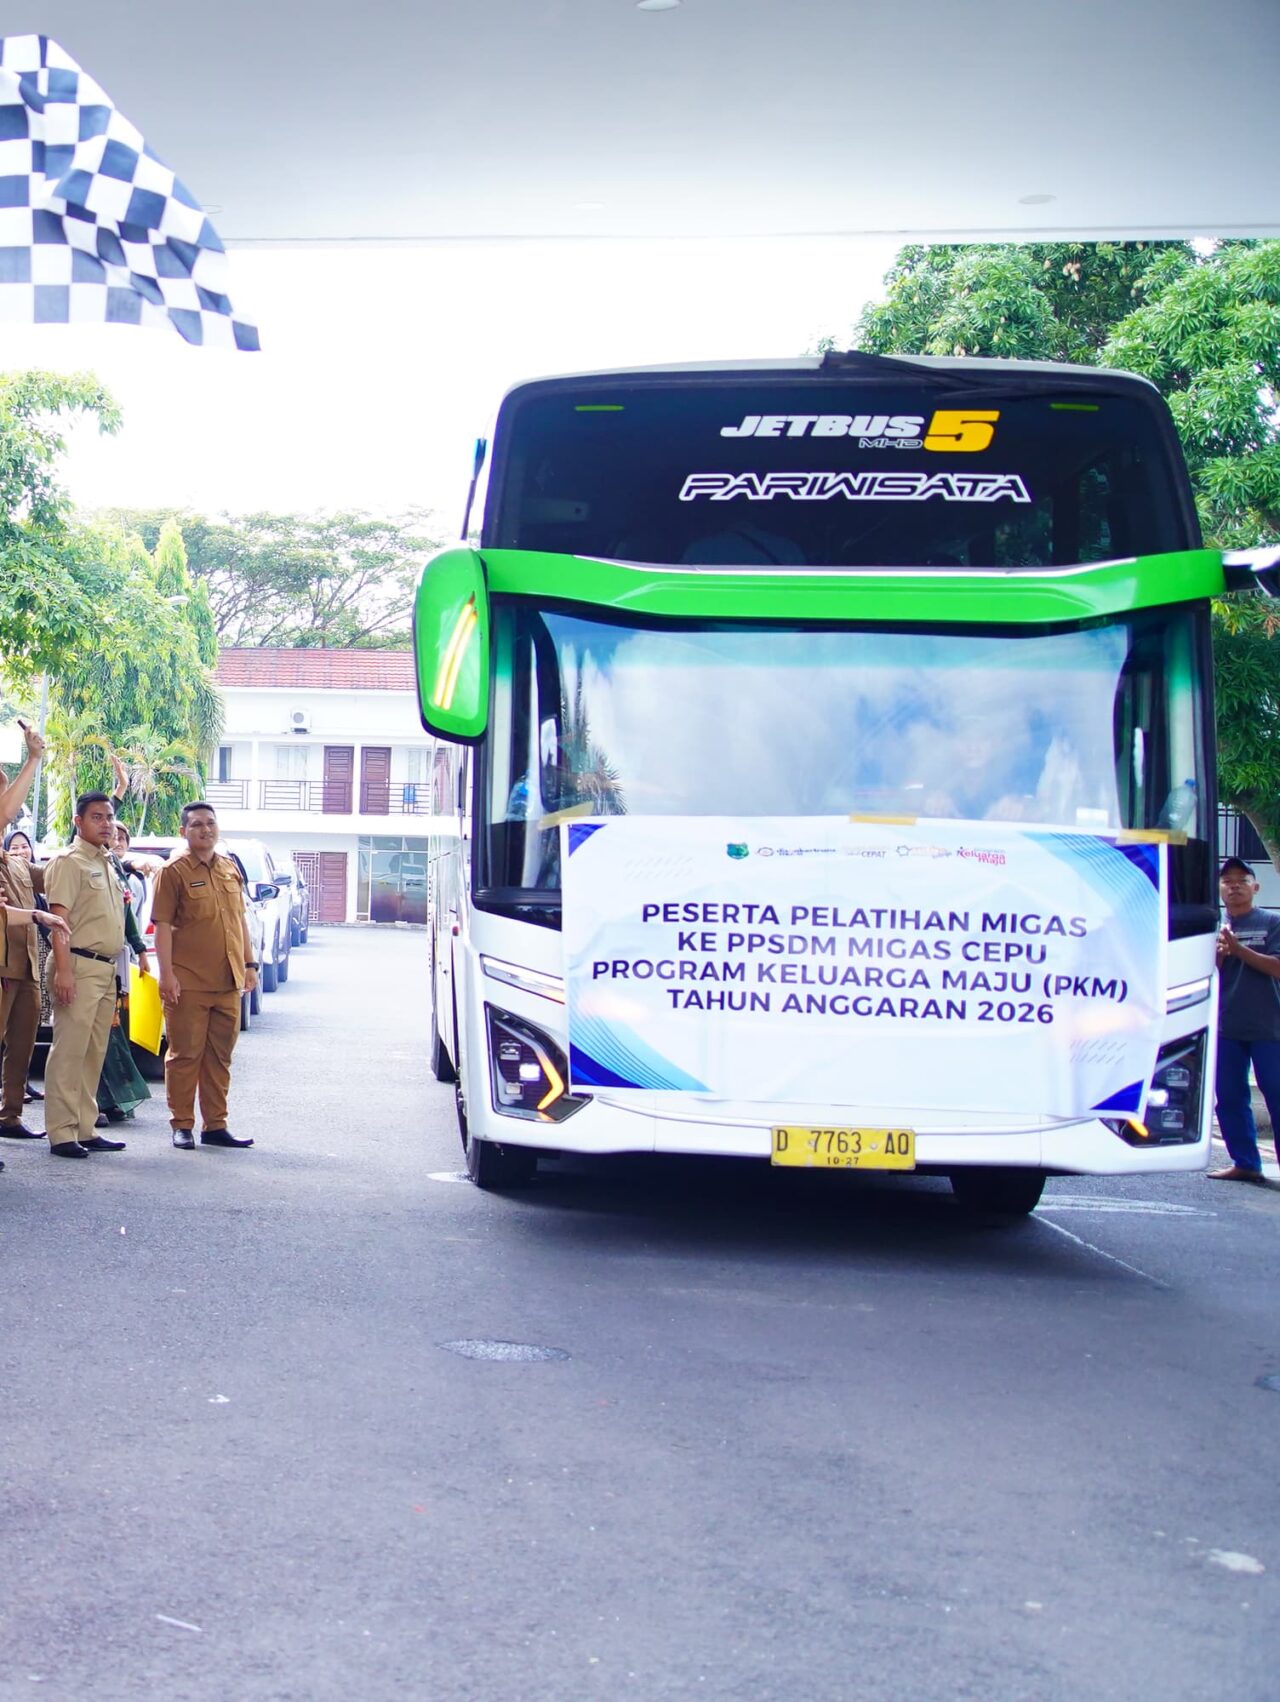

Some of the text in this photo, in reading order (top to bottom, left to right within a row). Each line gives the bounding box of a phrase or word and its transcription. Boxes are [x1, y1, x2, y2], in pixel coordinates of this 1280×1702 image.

[720, 410, 1000, 452] JETBUS 5
[859, 438, 923, 449] MHD
[679, 473, 1031, 502] PARIWISATA
[642, 903, 1088, 938] PESERTA PELATIHAN MIGAS
[678, 931, 1047, 965] KE PPSDM MIGAS CEPU
[592, 959, 1128, 1003] PROGRAM KELUARGA MAJU (PKM)
[666, 989, 1054, 1024] TAHUN ANGGARAN 2026
[776, 1129, 788, 1152] D
[810, 1130, 862, 1154] 7763
